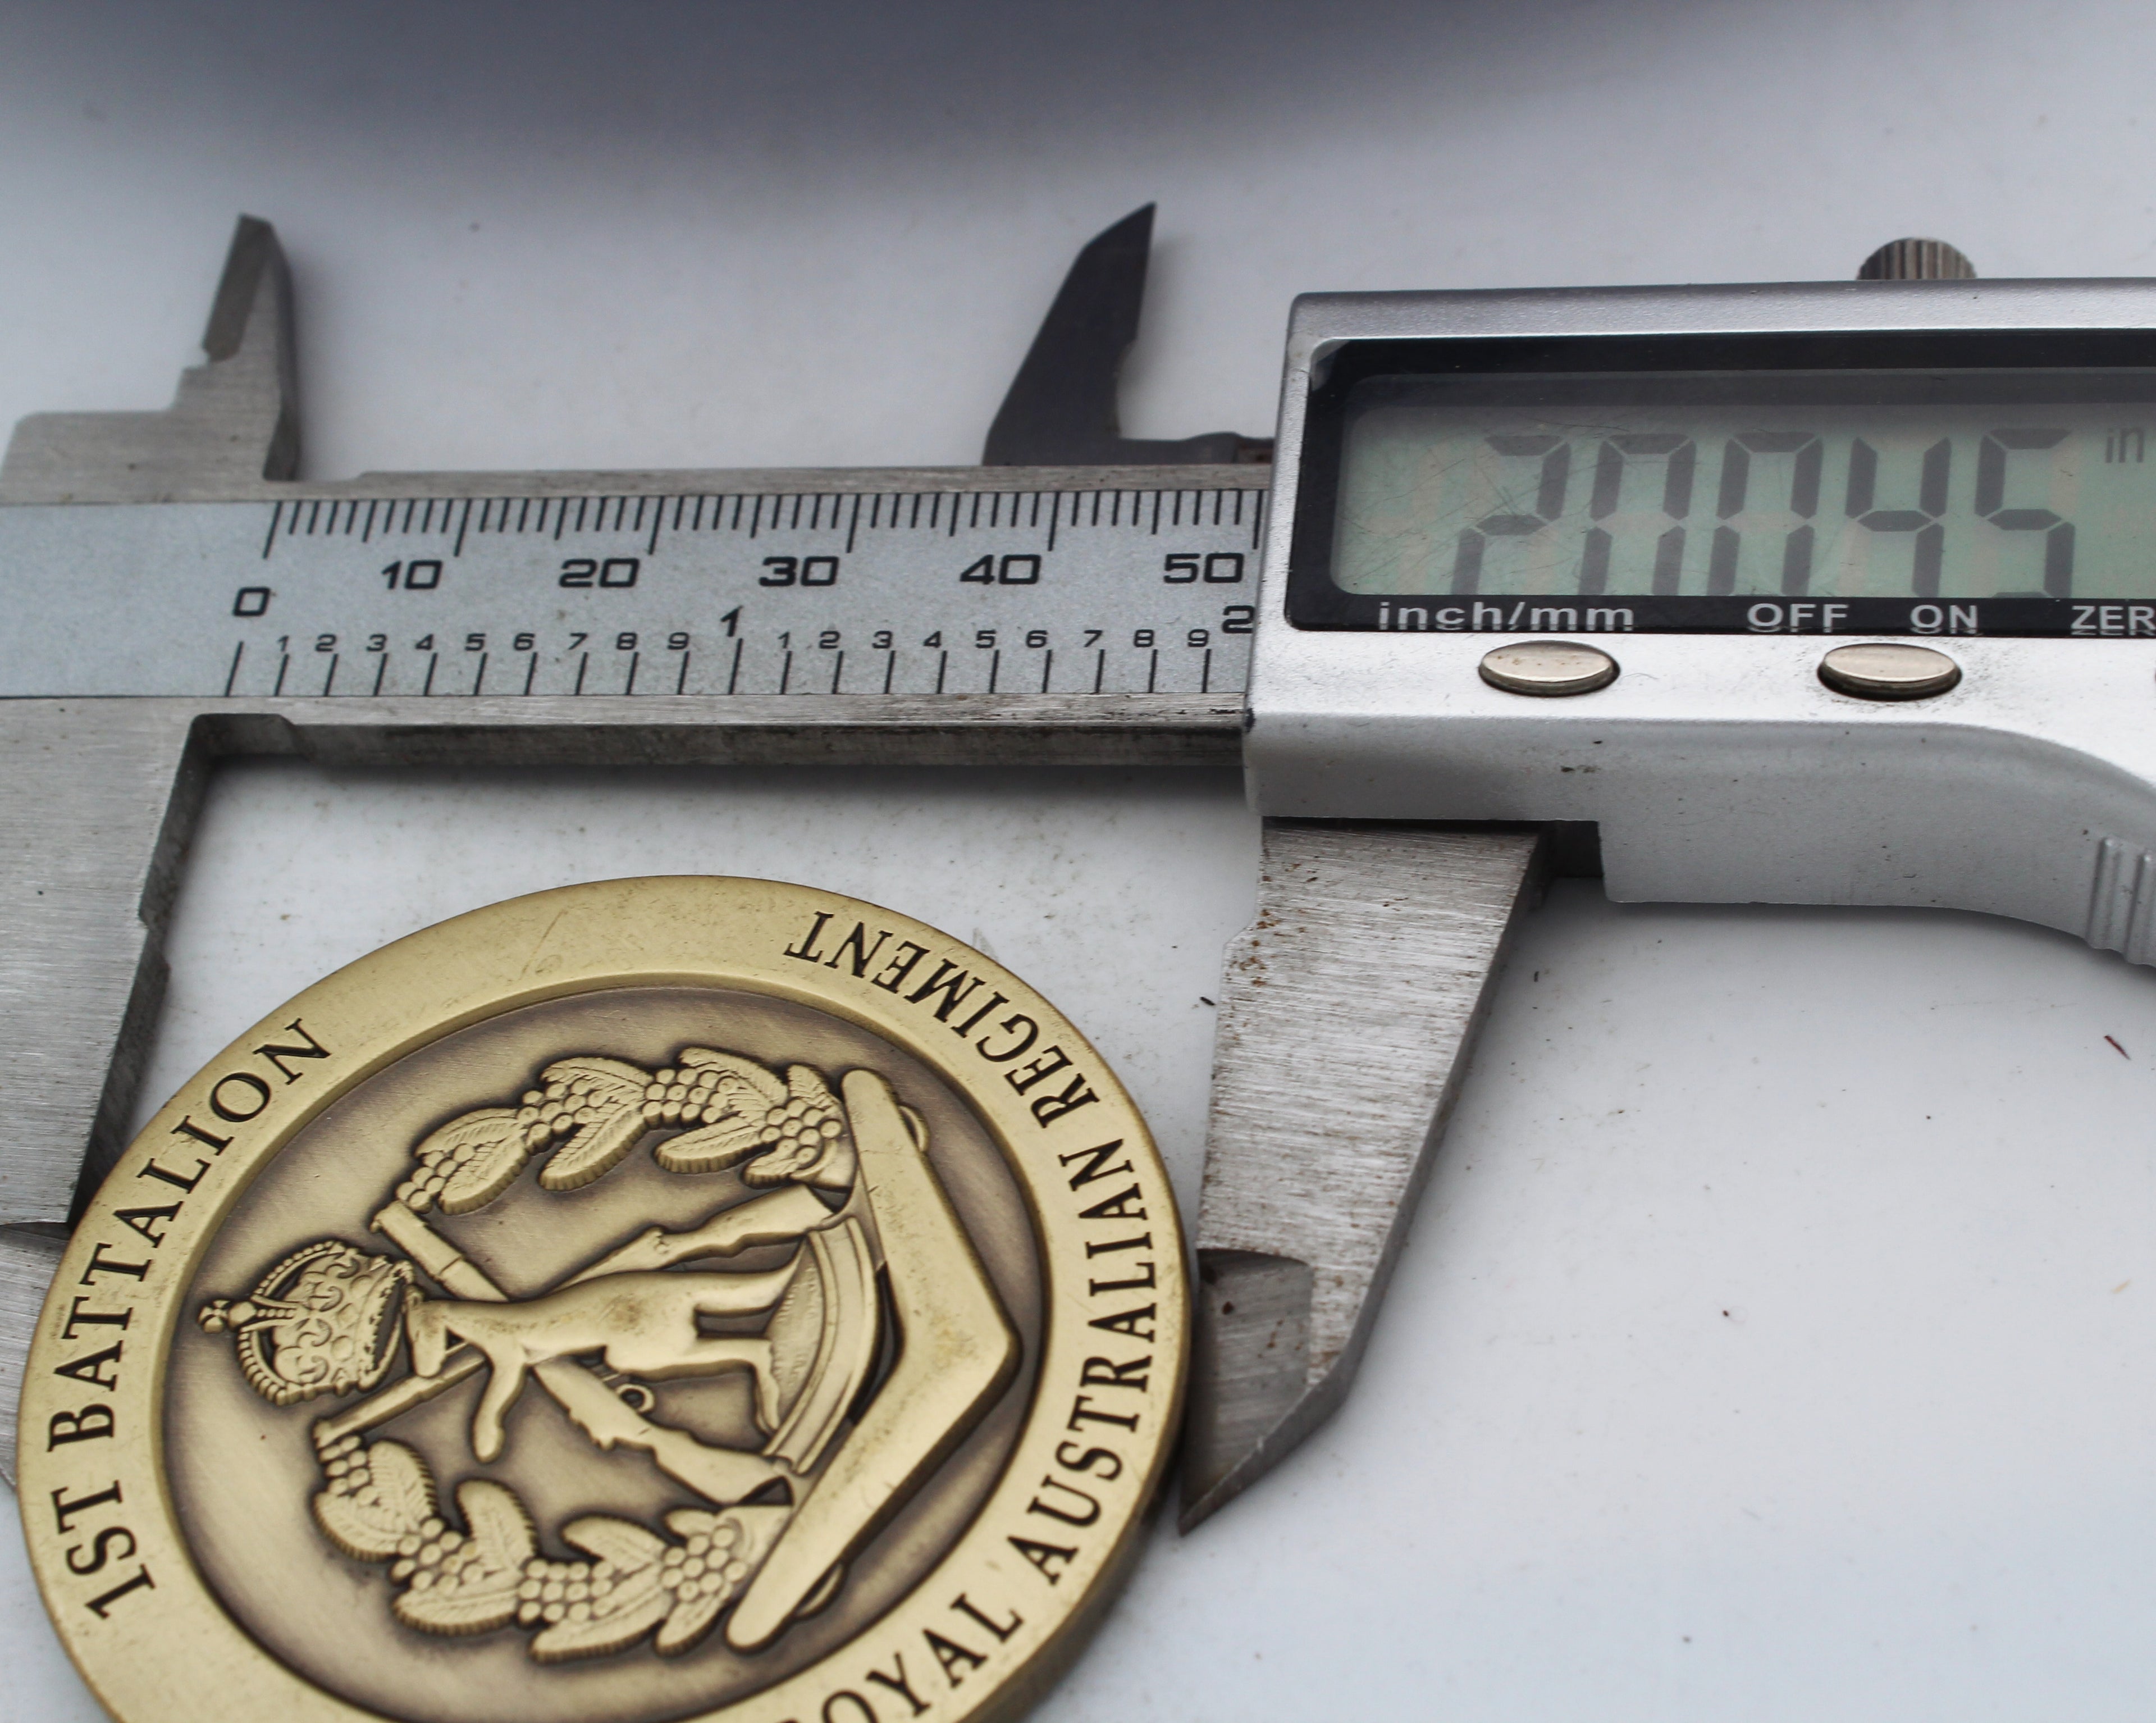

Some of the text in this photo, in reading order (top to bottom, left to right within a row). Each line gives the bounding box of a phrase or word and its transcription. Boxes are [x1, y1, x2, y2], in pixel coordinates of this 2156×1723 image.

[233, 553, 1244, 617] 0 10 20 30 40 50
[277, 605, 1255, 652] 1 2 3 4 5 6 7 8 9 1 1 2 3 4 5 6 7 8 9 2
[1379, 601, 1634, 629] inch/mm
[1747, 603, 1977, 631] OFF ON
[47, 1018, 334, 1620] 1ST BATTALION
[778, 910, 1157, 1723] OYAL AUSTRALIAN REGIMENT
